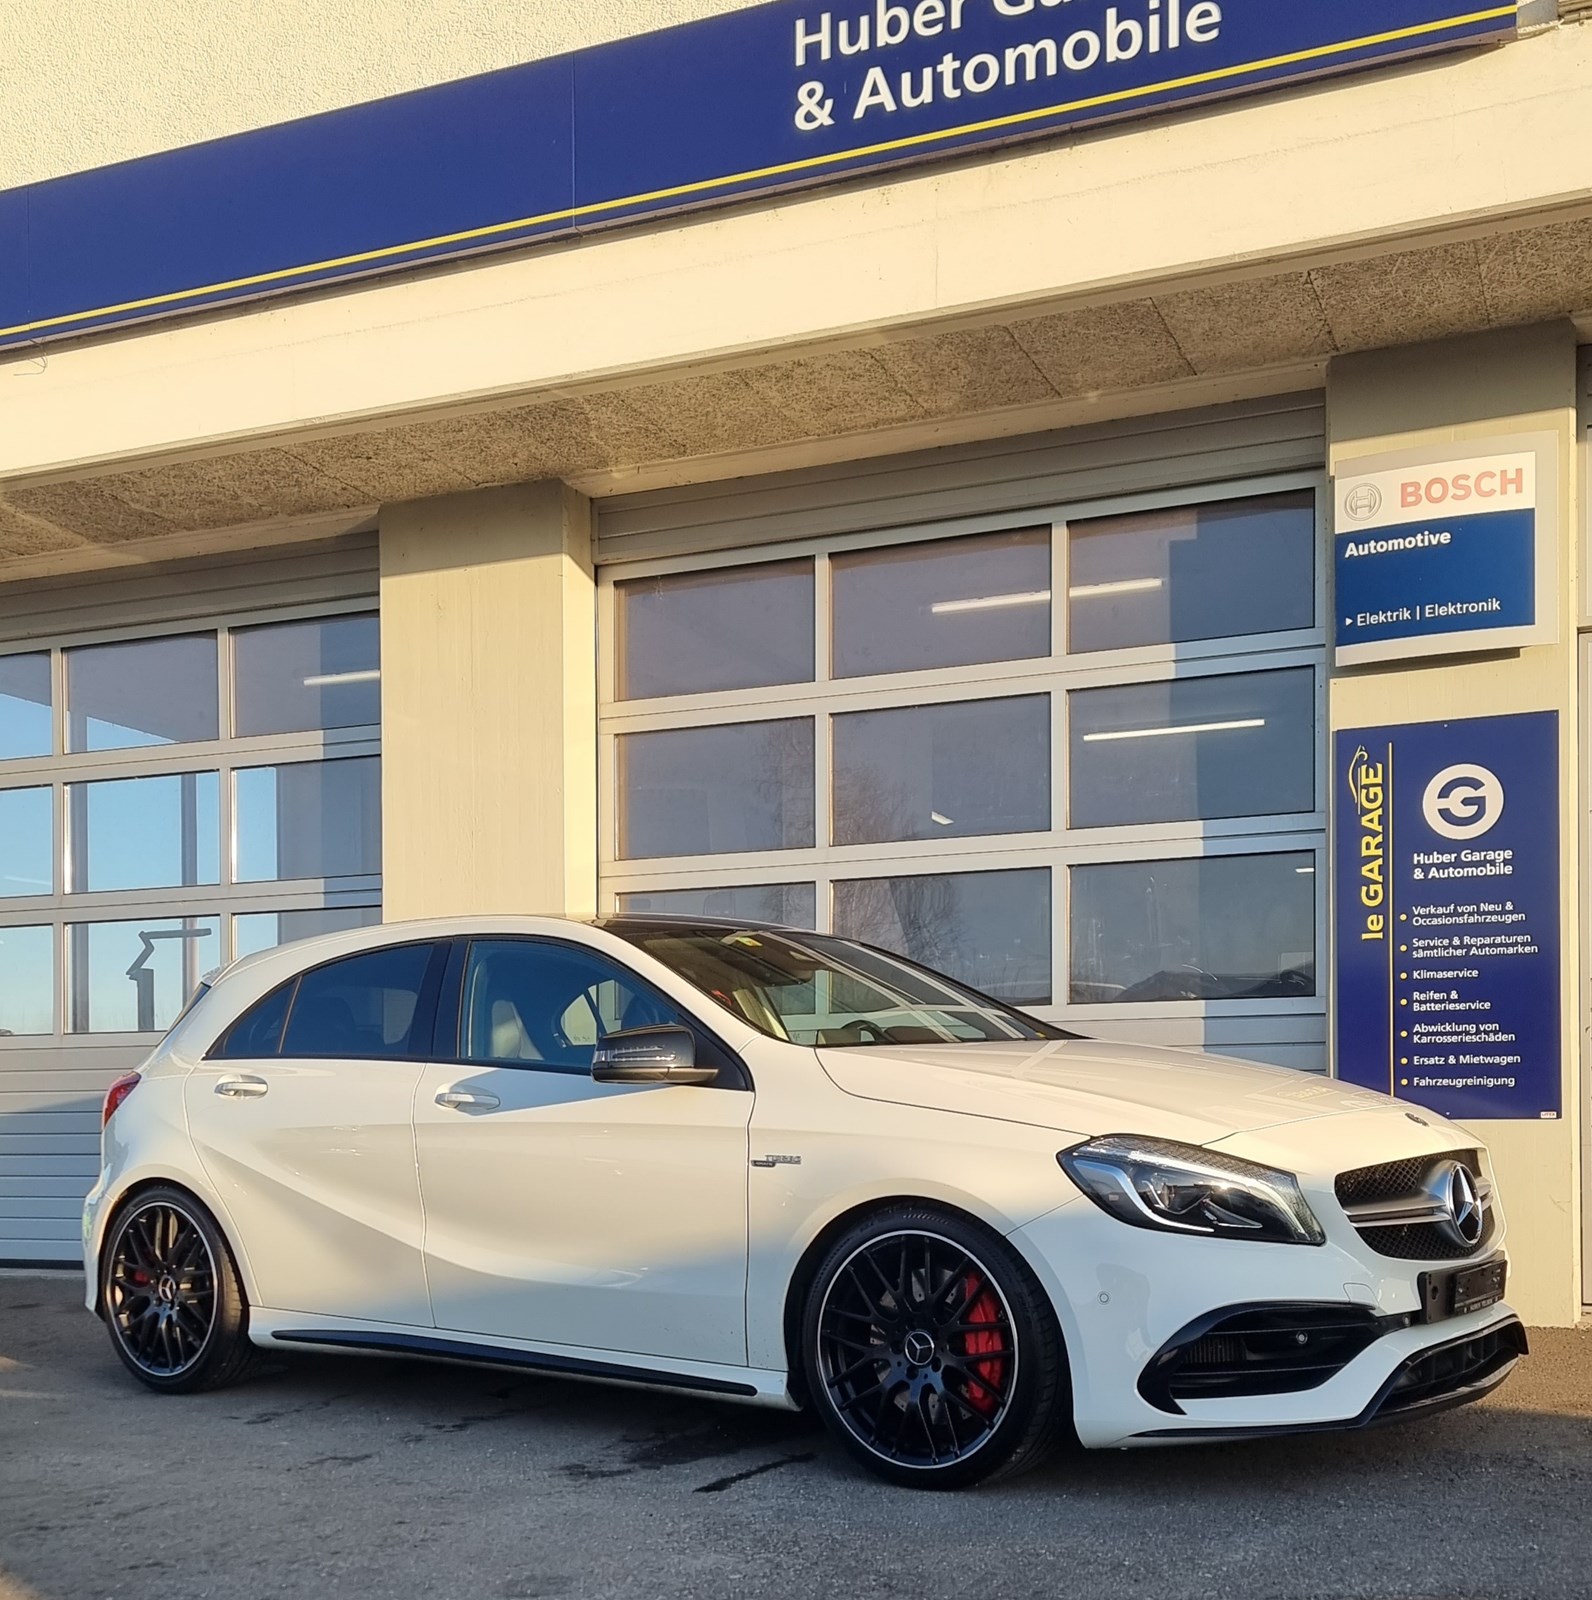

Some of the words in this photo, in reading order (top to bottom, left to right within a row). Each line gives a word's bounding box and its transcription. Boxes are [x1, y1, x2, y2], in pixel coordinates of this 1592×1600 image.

[795, 0, 970, 67] Huber
[794, 81, 834, 130] &
[853, 0, 1222, 120] Automobile
[1401, 468, 1523, 508] BOSCH
[1345, 530, 1451, 558] Automotive
[1357, 607, 1411, 626] Elektrik
[1426, 598, 1501, 618] Elektronik
[1361, 763, 1383, 907] GARAGE
[1413, 851, 1457, 864] Huber
[1460, 849, 1513, 862] Garage
[1413, 868, 1425, 879] &
[1428, 863, 1513, 879] Automobile
[1413, 904, 1454, 915] Verkauf
[1457, 904, 1477, 913] von
[1480, 902, 1501, 912] Neu
[1505, 901, 1513, 911] &
[1413, 912, 1526, 926] Occasionsfahrzeugen
[1362, 914, 1383, 940] le
[1413, 937, 1449, 947] Service
[1453, 936, 1461, 946] &
[1464, 934, 1531, 946] Reparaturen
[1412, 946, 1467, 958] sämtlicher
[1470, 944, 1538, 956] Automarken
[1413, 968, 1479, 979] Klimaservice
[1413, 991, 1447, 1000] Reifen
[1450, 991, 1458, 1000] &
[1413, 1001, 1491, 1012] Batterieservice
[1413, 1023, 1476, 1034] Abwicklung
[1479, 1023, 1499, 1031] von
[1413, 1032, 1515, 1043] Karrosserieschäden
[1413, 1055, 1445, 1065] Ersatz
[1448, 1055, 1457, 1064] &
[1459, 1054, 1520, 1066] Mietwagen
[1413, 1076, 1515, 1088] Fahrzeugreinigung
